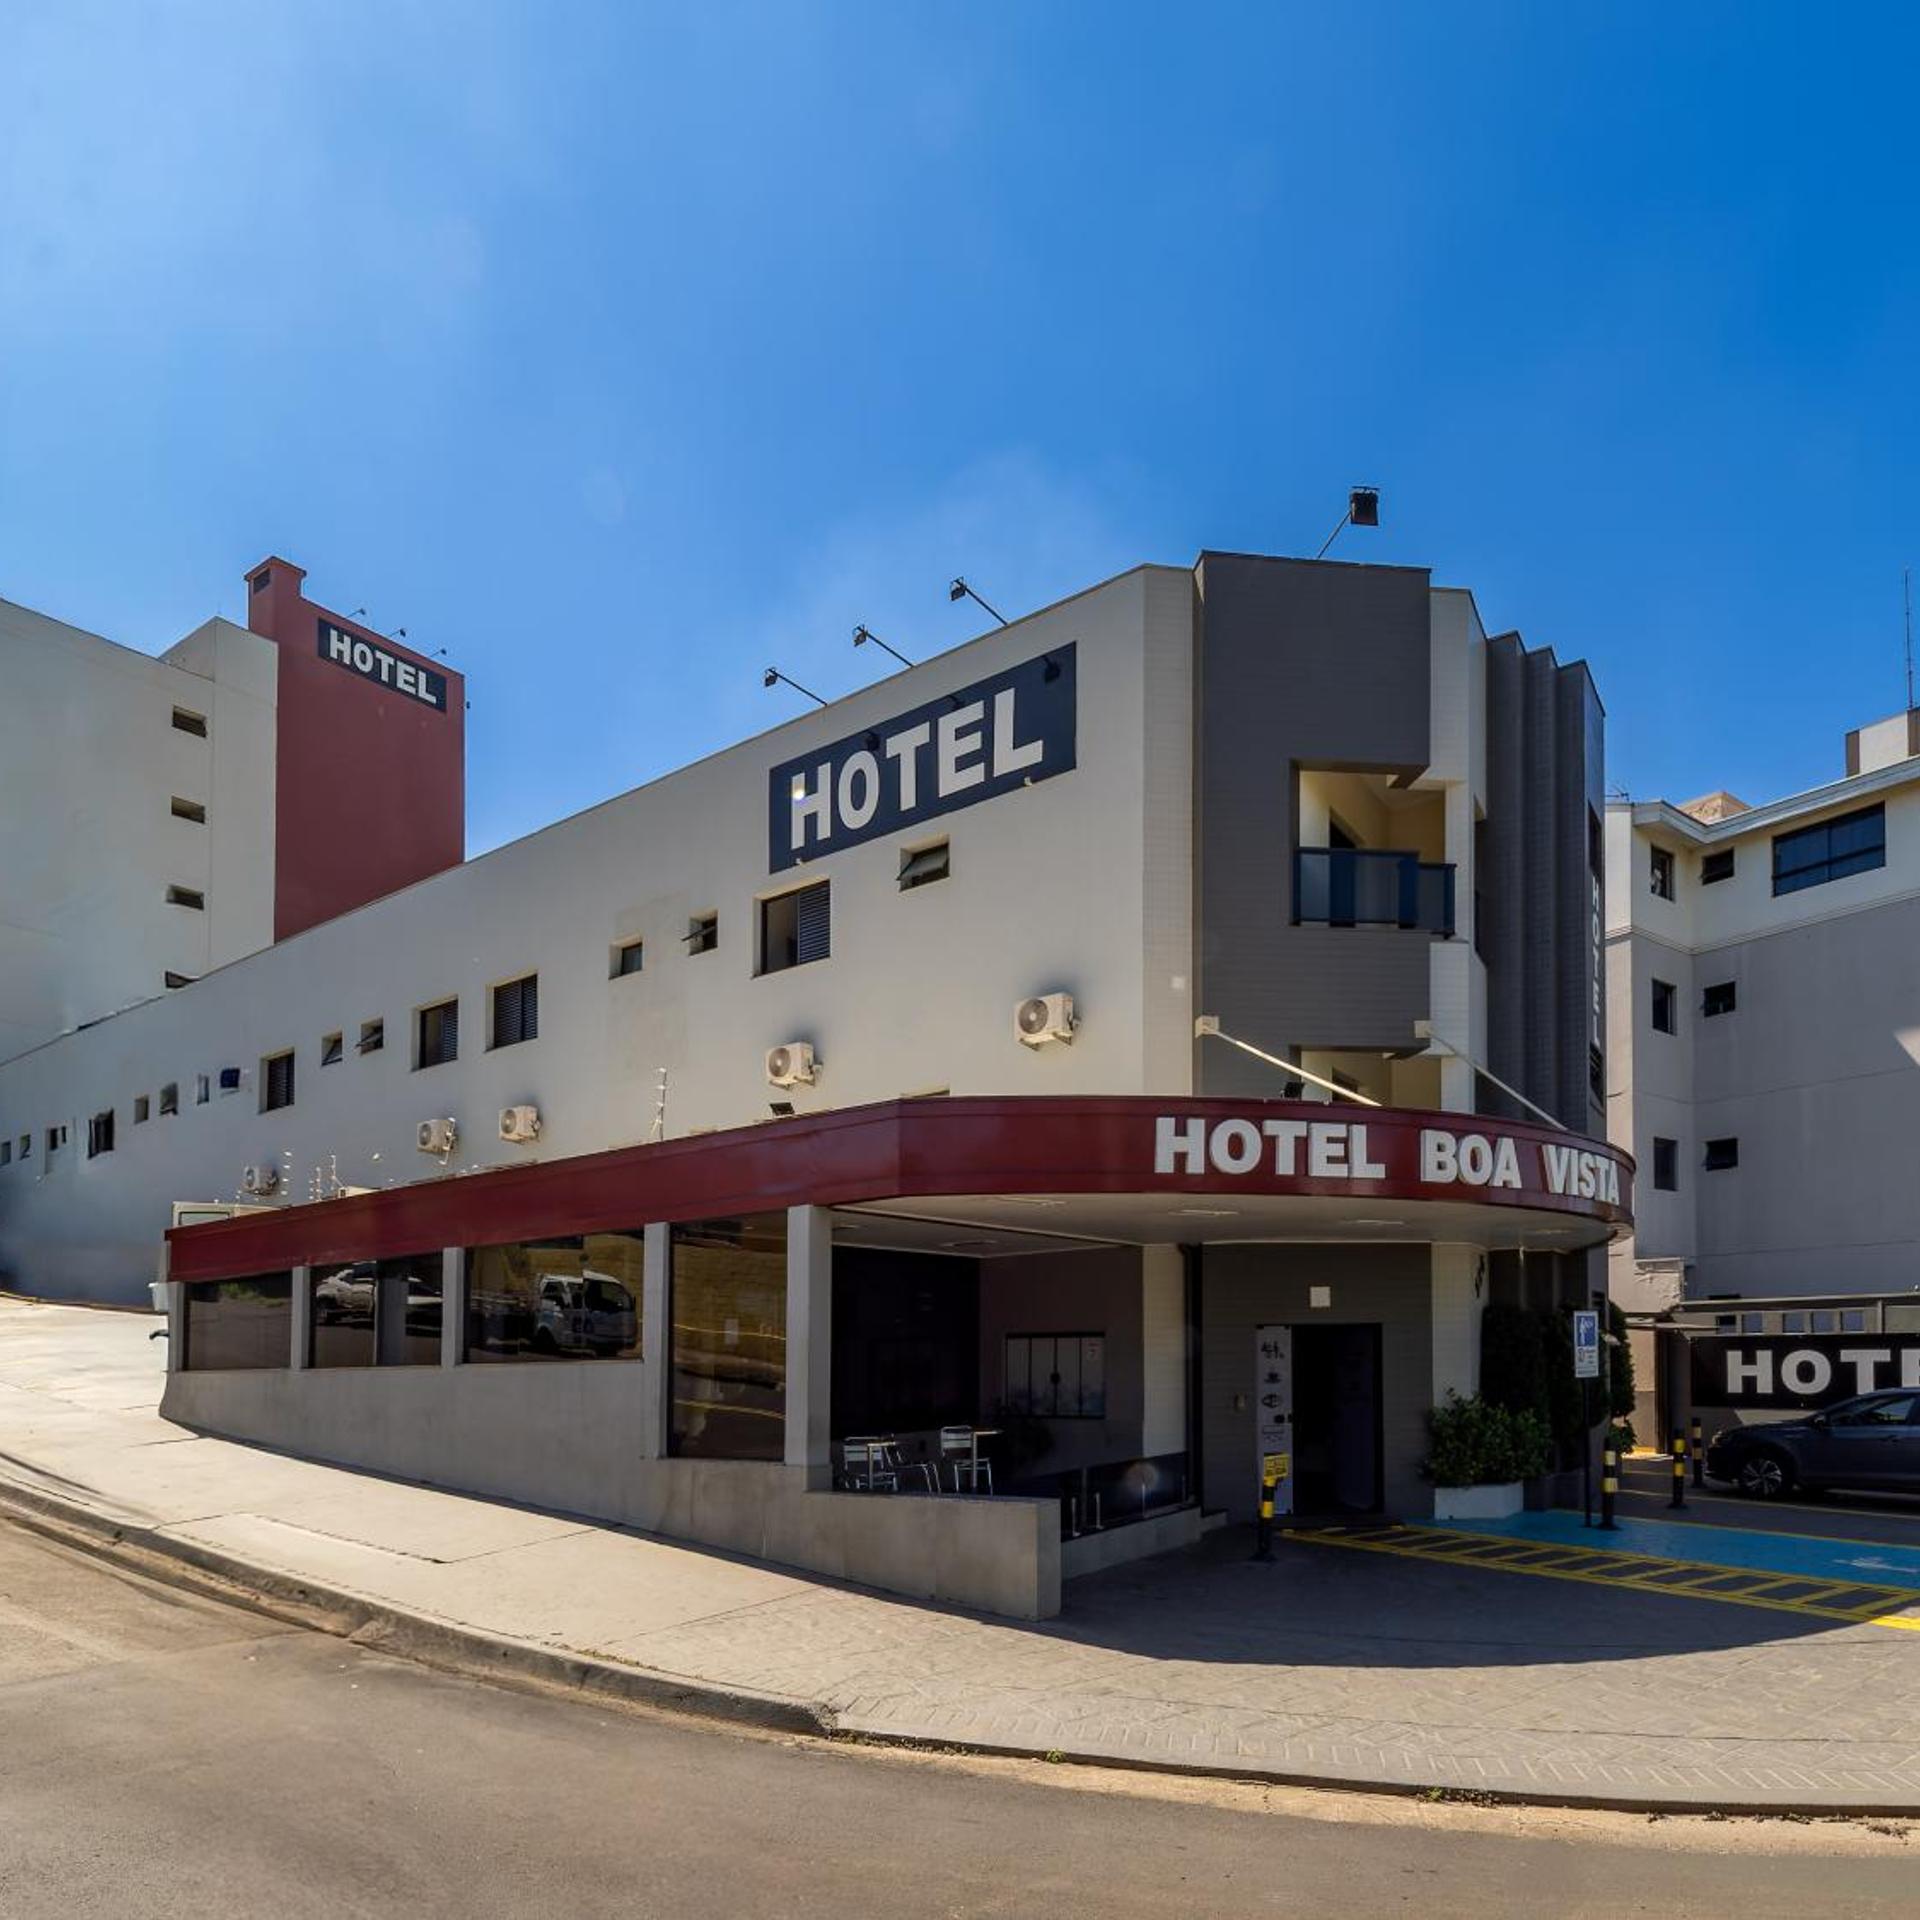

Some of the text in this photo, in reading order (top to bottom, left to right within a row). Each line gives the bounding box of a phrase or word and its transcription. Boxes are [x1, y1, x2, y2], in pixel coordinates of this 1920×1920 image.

[329, 628, 437, 704] HOTEL
[791, 687, 1043, 849] HOTEL
[1591, 874, 1601, 1049] HOTEL
[1154, 1117, 1620, 1206] HOTEL BOA VISTA
